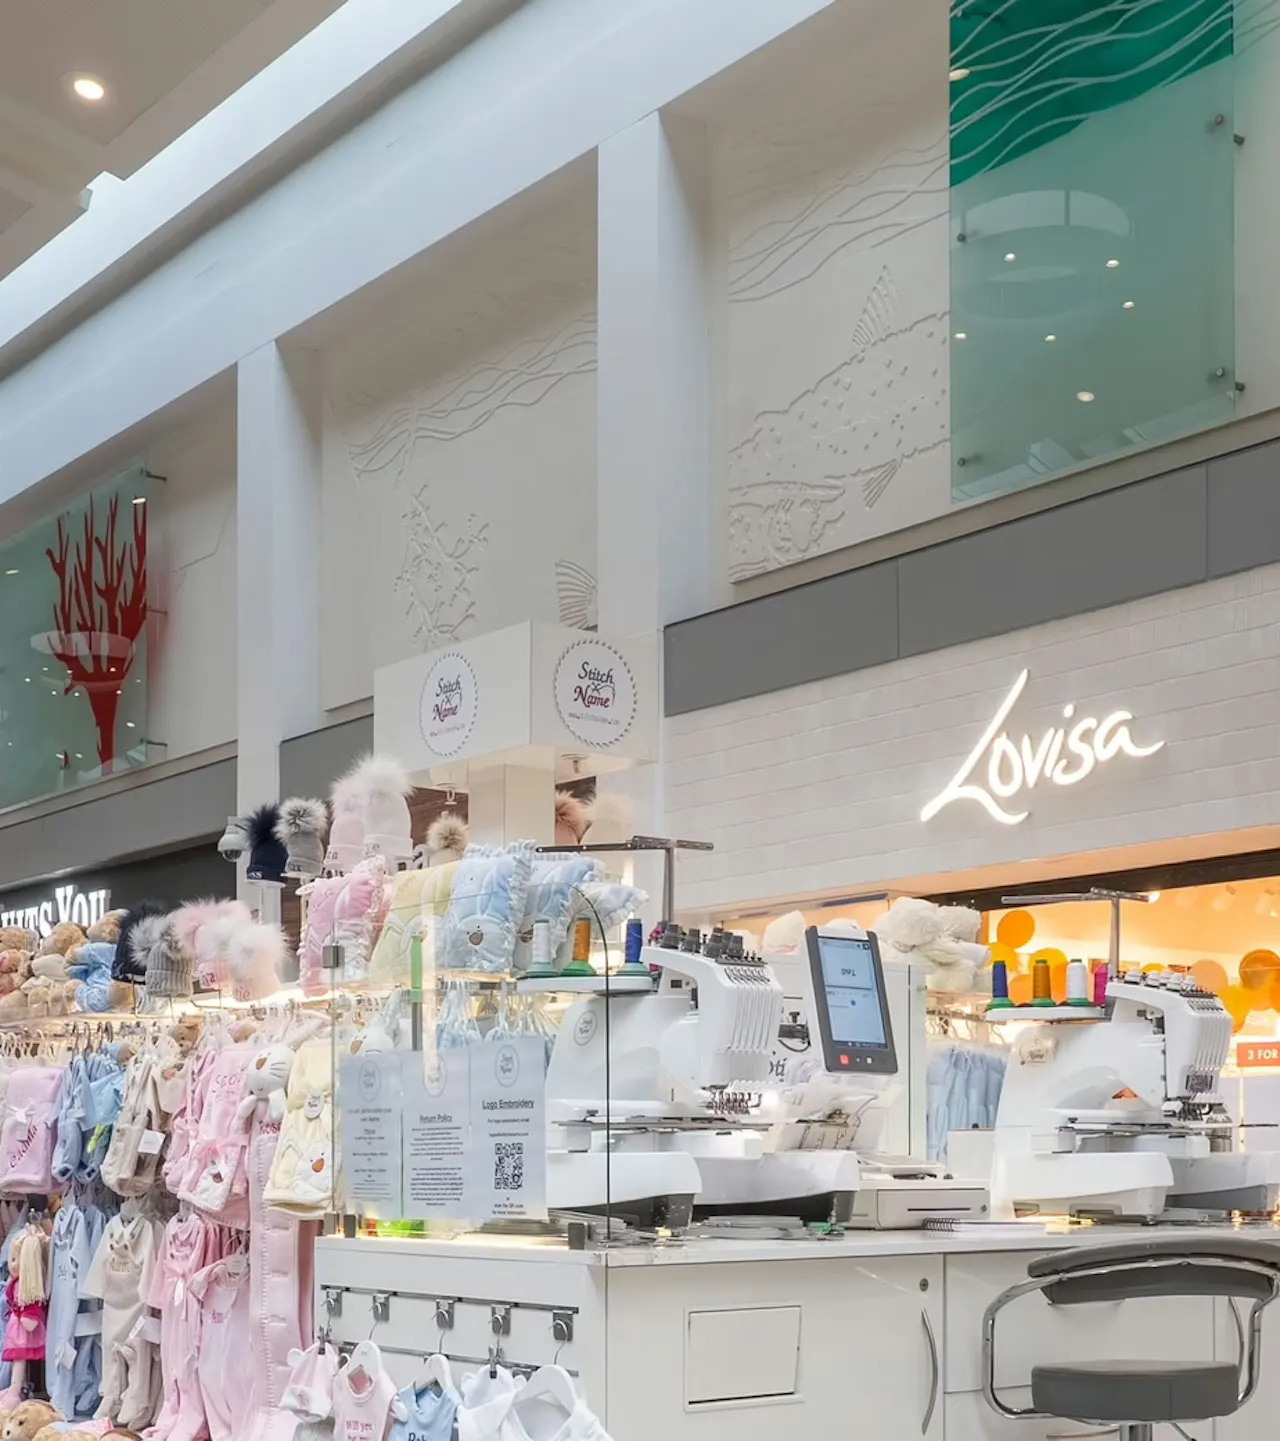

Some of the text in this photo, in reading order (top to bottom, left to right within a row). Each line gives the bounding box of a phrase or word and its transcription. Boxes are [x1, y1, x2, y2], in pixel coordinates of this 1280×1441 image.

[578, 661, 614, 685] Stitch
[436, 674, 462, 698] Stitch
[573, 684, 610, 709] Name
[432, 699, 460, 723] Name
[920, 668, 1166, 826] Lovisa
[1247, 1049, 1255, 1060] 3
[1257, 1048, 1279, 1060] FOR
[482, 1100, 535, 1110] Logo Embroidery
[438, 1114, 453, 1123] Policy
